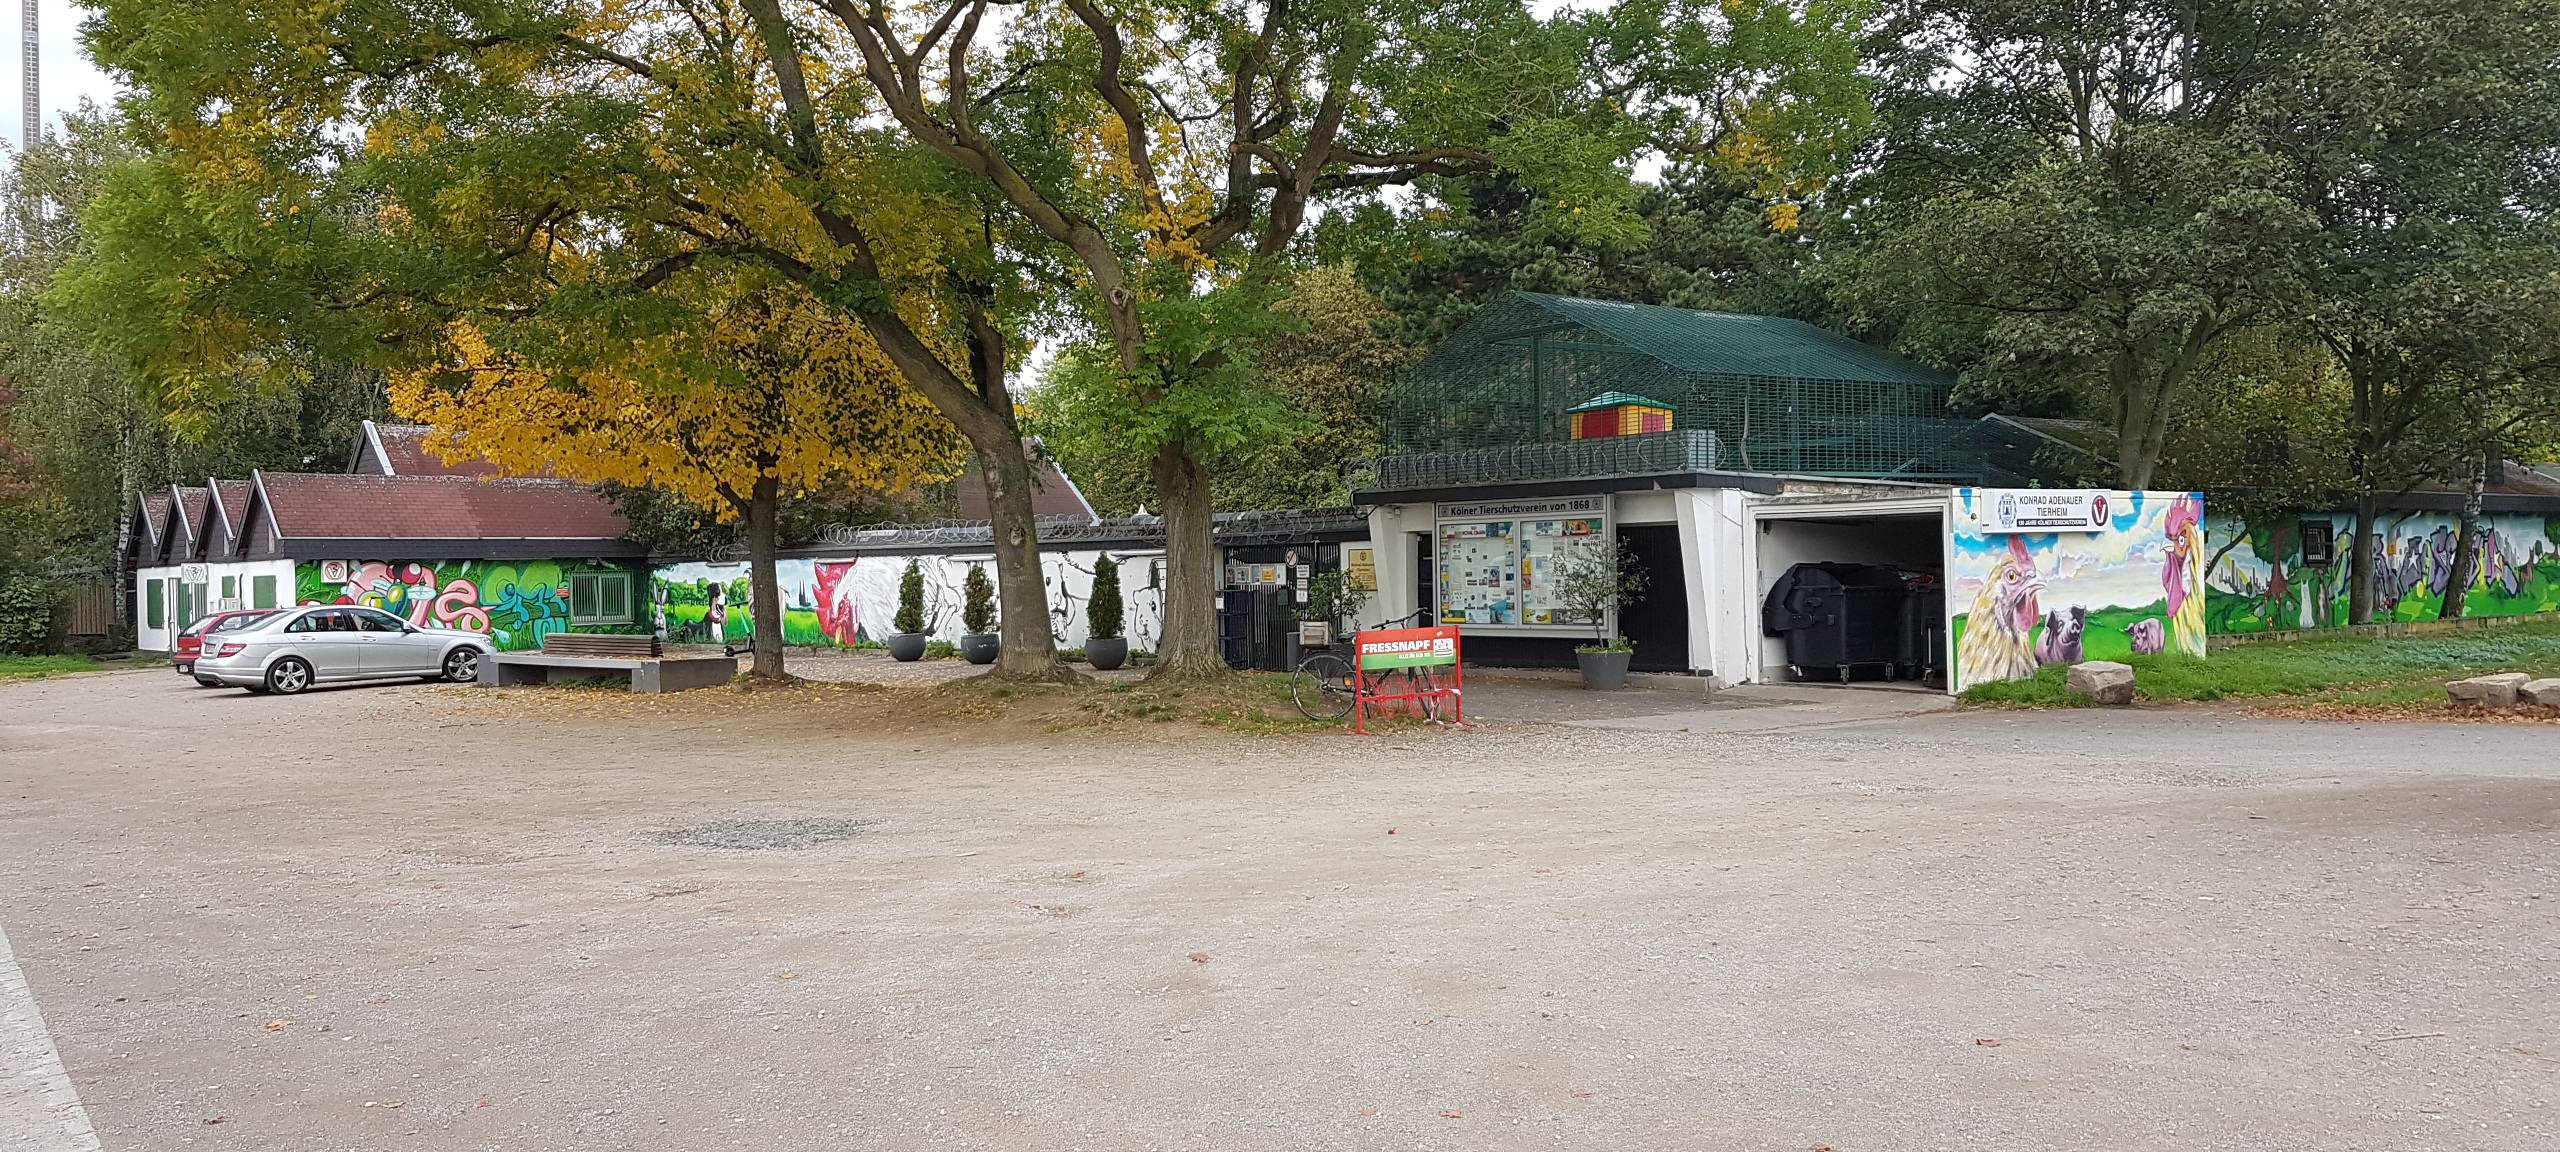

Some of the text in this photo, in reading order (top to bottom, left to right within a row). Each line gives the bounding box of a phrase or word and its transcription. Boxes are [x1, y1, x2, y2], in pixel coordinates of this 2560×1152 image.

[2019, 495, 2083, 505] KONRAD ADENAUER
[1451, 500, 1590, 516] Kölner Tierschutzverein von 1868
[2037, 507, 2068, 517] TIERHEIM
[1362, 640, 1430, 653] FRESSNAPF
